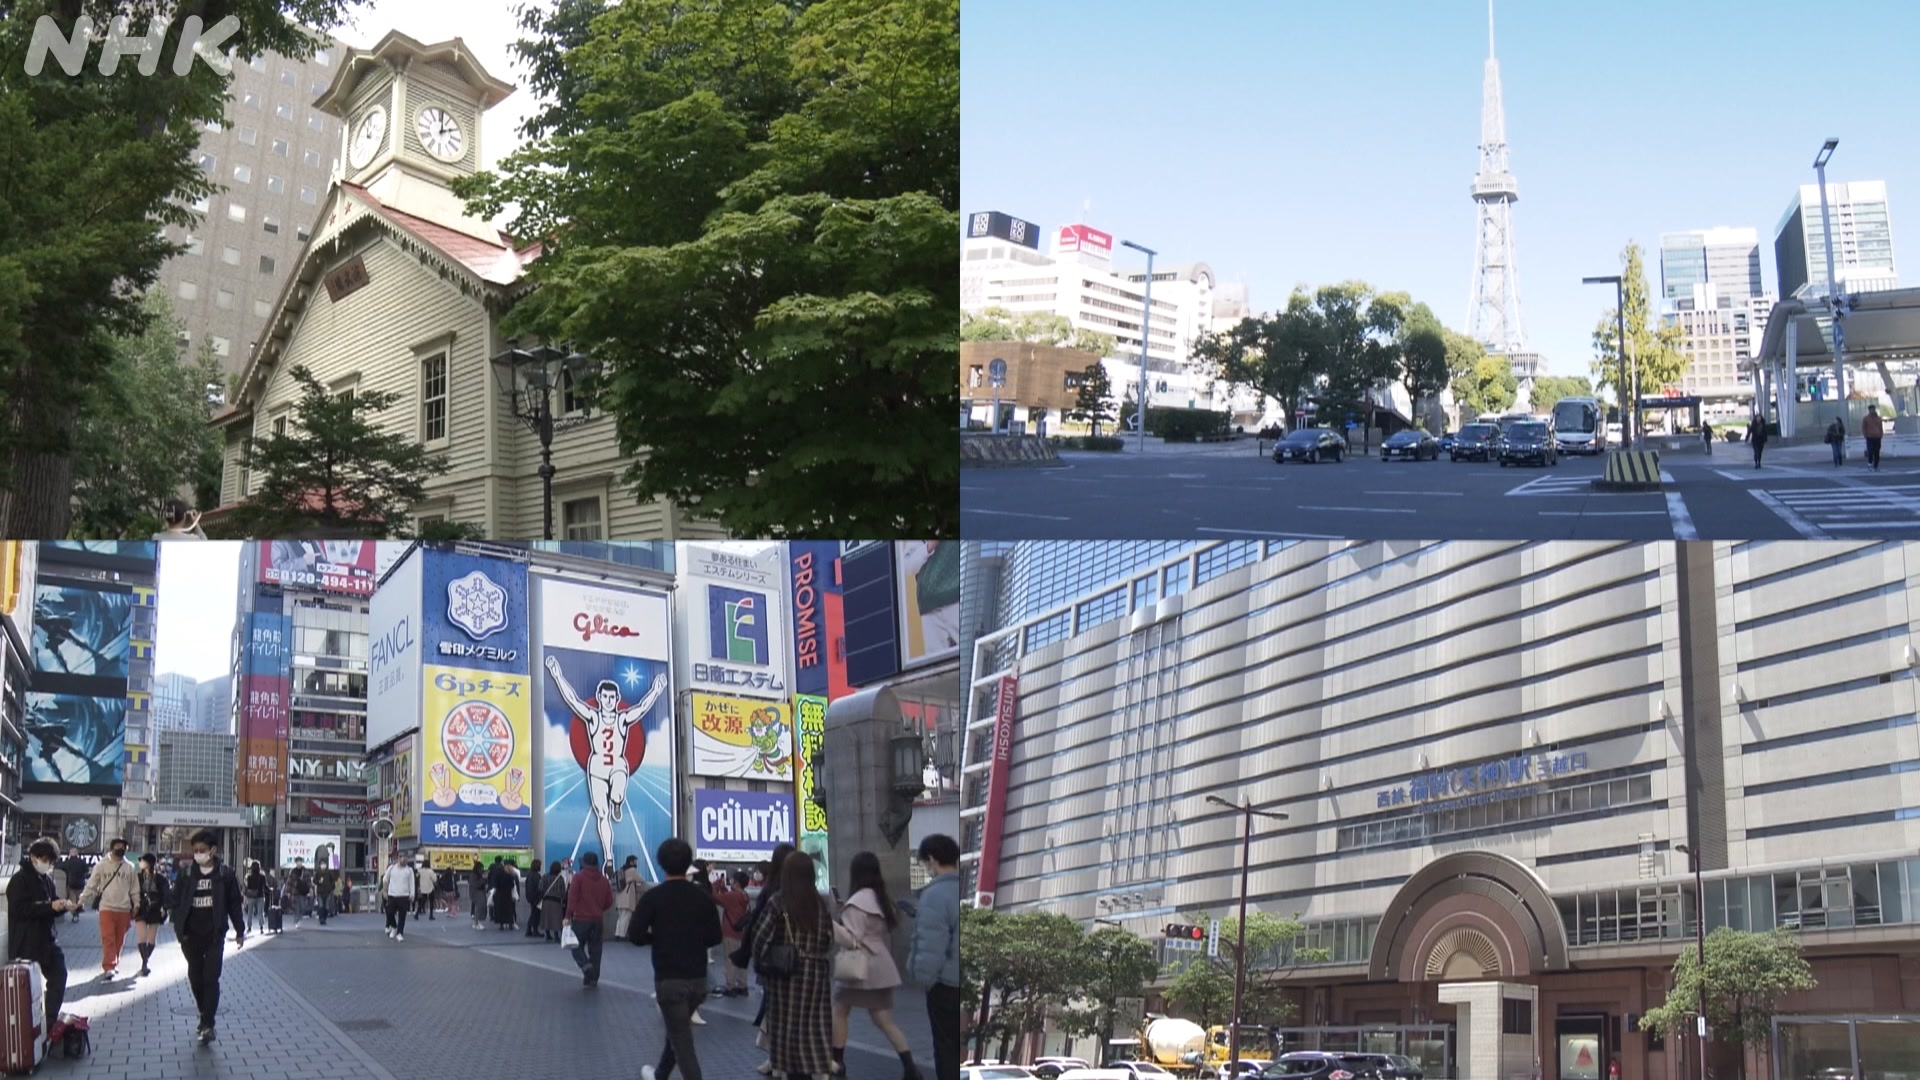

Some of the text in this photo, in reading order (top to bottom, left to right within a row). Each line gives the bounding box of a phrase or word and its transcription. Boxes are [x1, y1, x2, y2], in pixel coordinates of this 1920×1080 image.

[703, 565, 766, 584] エステムシリーズ
[711, 553, 757, 569] 夢ある住まい
[794, 552, 818, 669] PROMISE
[573, 612, 640, 641] Glico
[371, 615, 413, 677] FANCL
[439, 641, 517, 661] 雪印メグミルク
[693, 663, 784, 690] 日商エステム
[705, 700, 740, 715] かぜに
[701, 714, 744, 734] 改源
[997, 683, 1015, 760] MITSUKOSHI
[601, 730, 614, 766] グリコ
[289, 757, 321, 776] NY
[701, 798, 790, 842] CHINTAI
